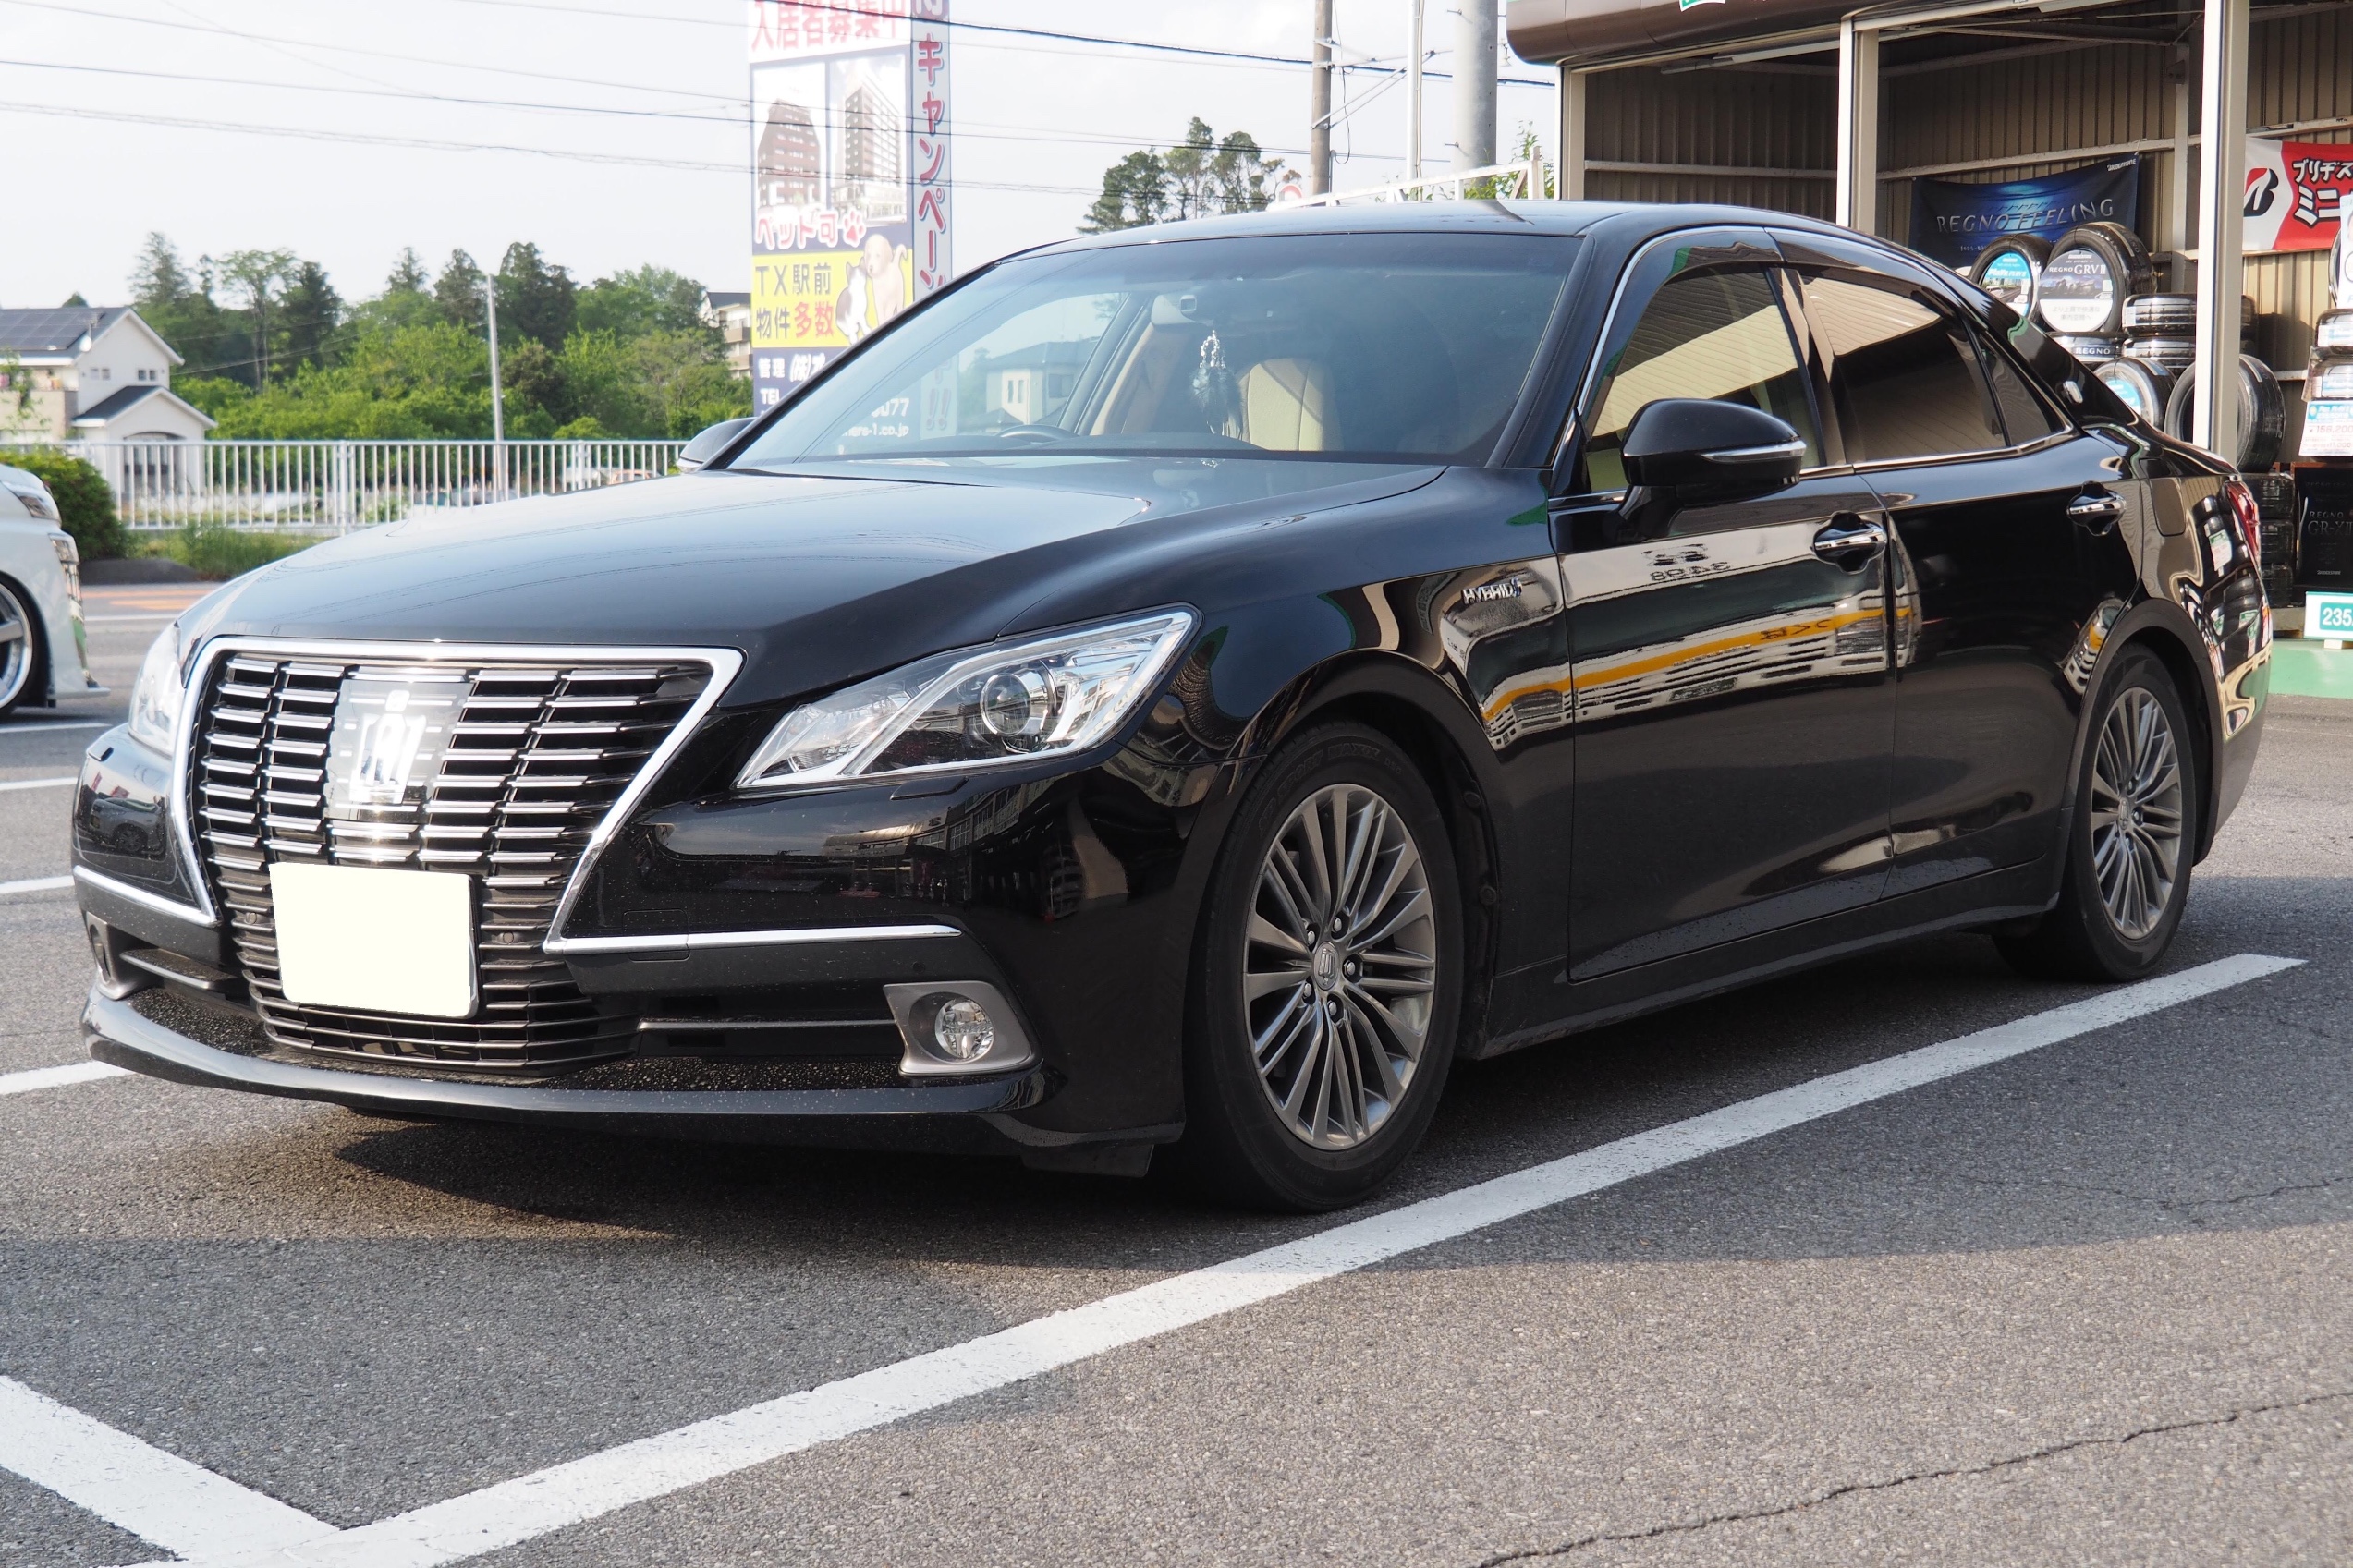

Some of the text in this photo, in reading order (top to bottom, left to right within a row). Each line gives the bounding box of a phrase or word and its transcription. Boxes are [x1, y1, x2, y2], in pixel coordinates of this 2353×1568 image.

[756, 213, 836, 248] ペット可
[1936, 213, 2010, 233] REGNO
[755, 263, 832, 297] TX駅前
[755, 301, 835, 340] 物件多数
[2075, 346, 2112, 356] REGNO
[759, 357, 786, 379] 管理
[2309, 510, 2345, 519] REGNO
[1462, 583, 1514, 605] HYBRID
[2322, 607, 2353, 627] 235
